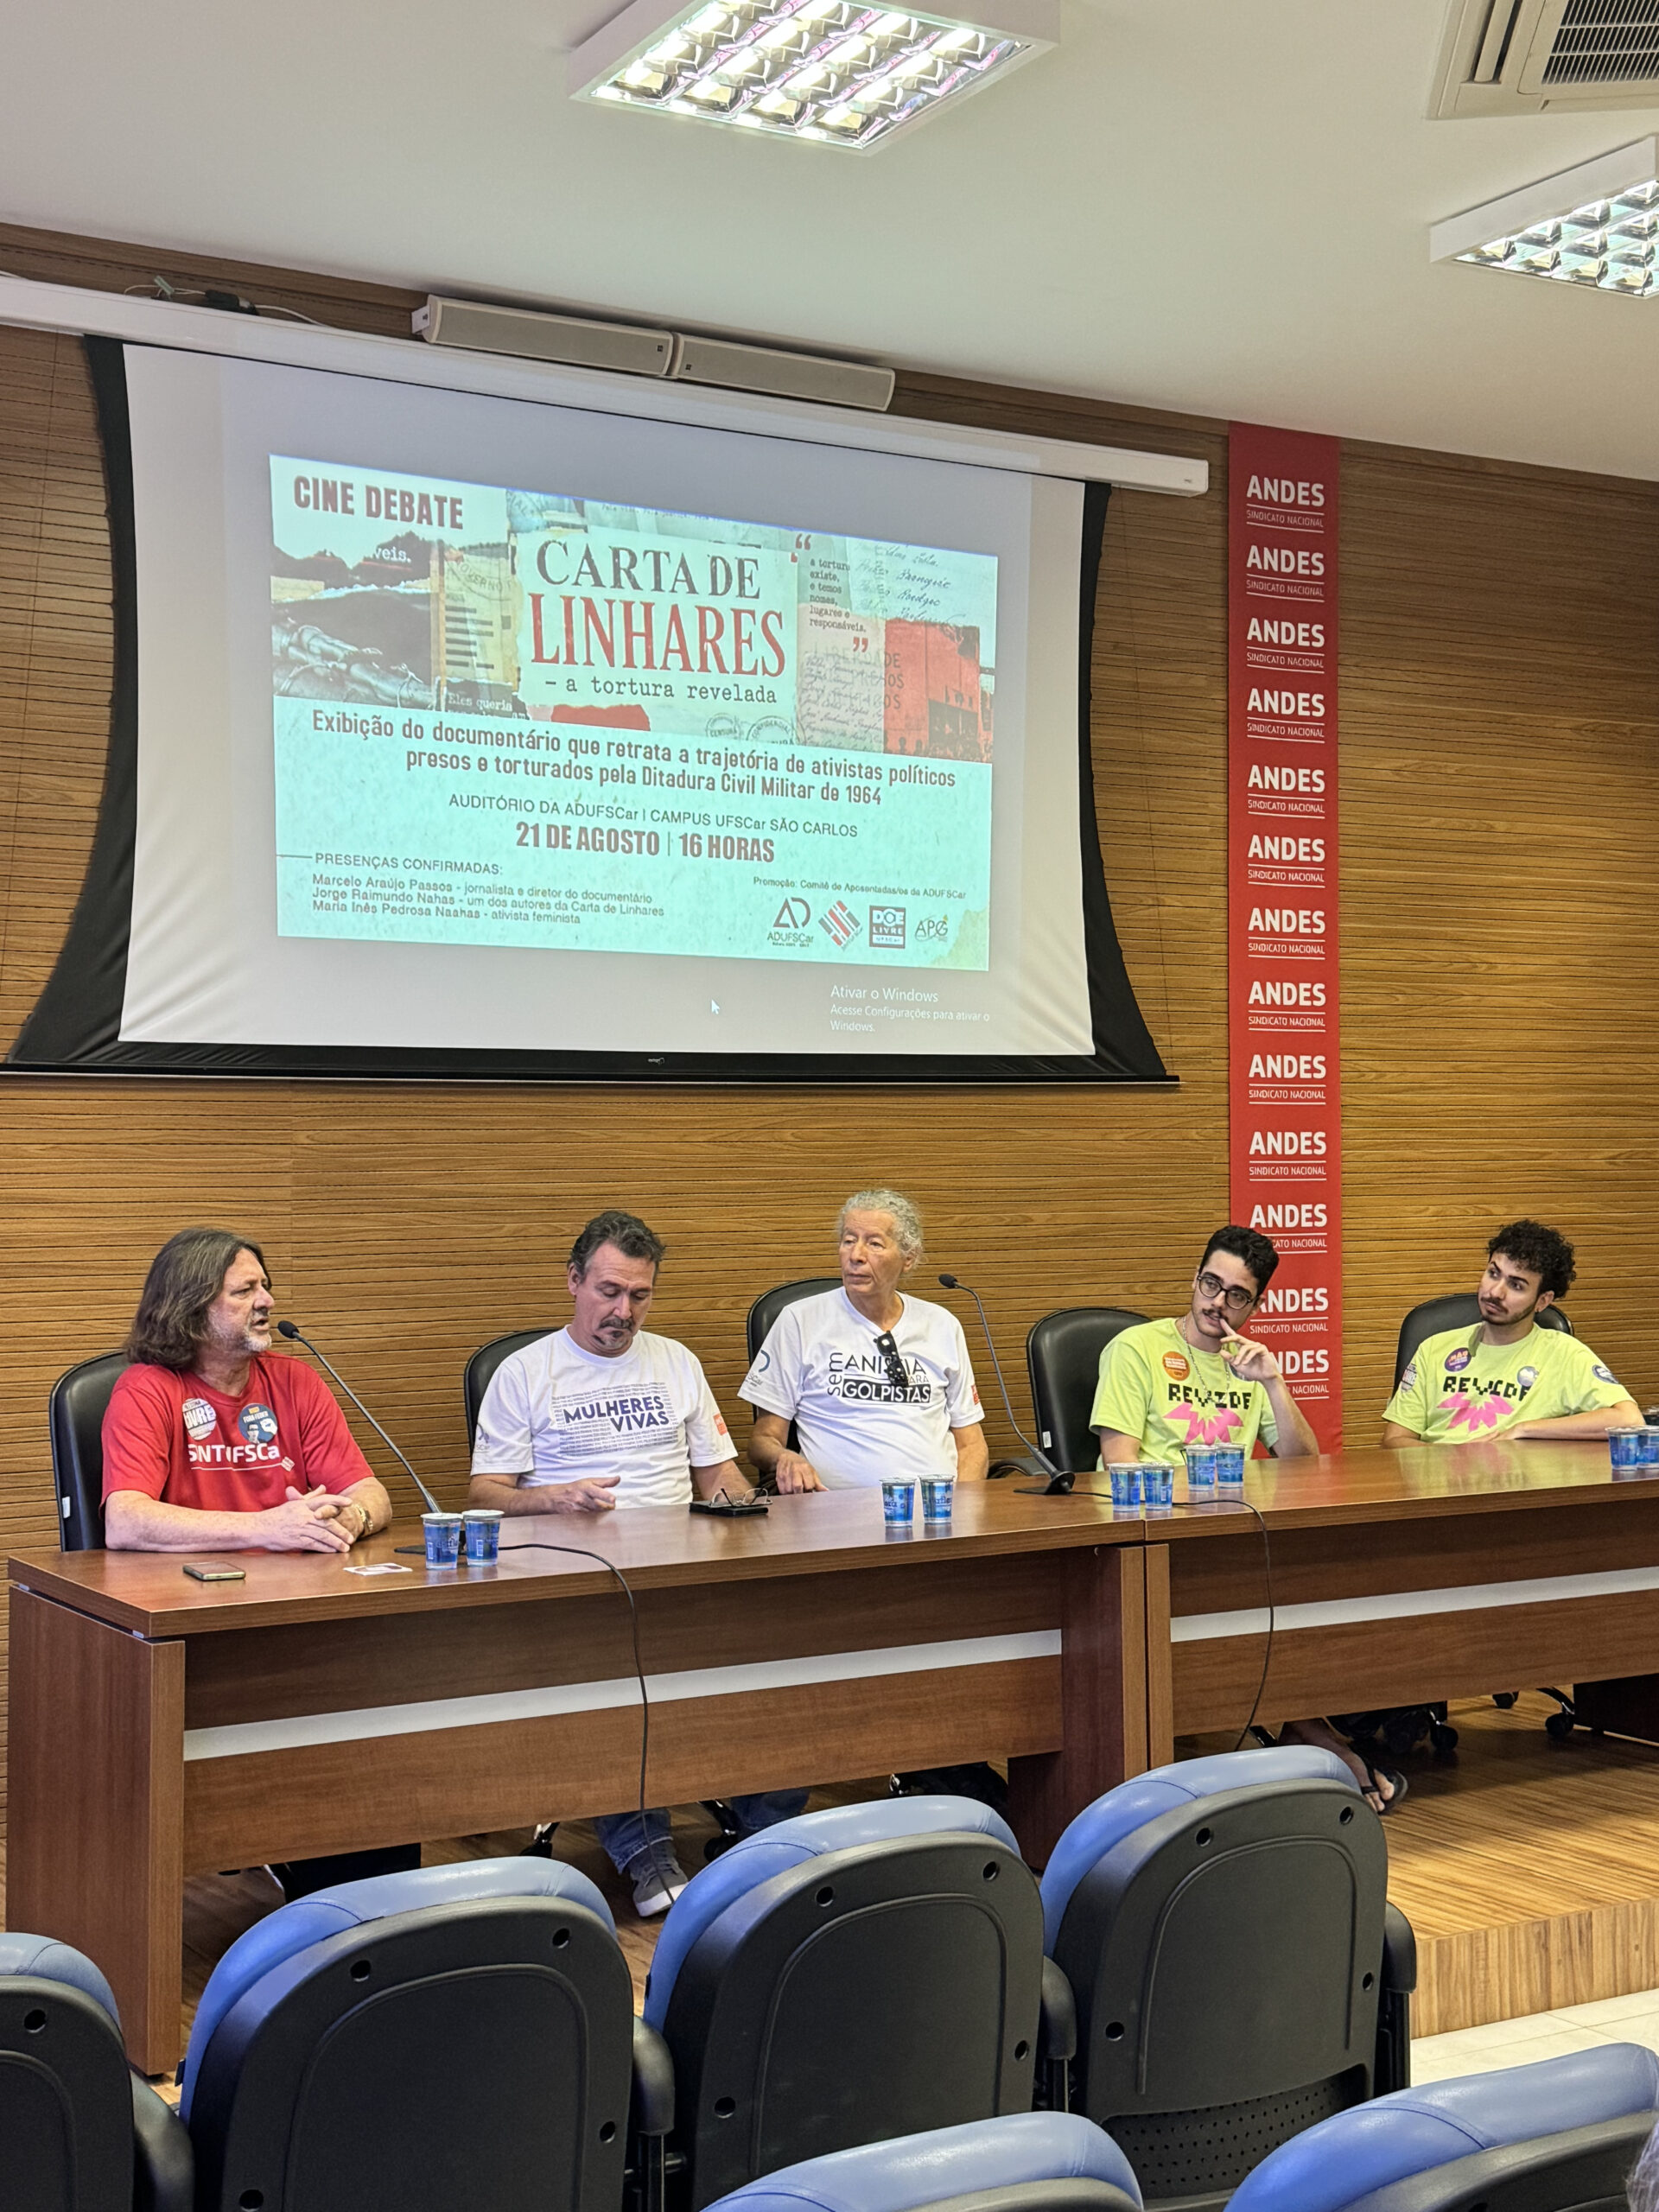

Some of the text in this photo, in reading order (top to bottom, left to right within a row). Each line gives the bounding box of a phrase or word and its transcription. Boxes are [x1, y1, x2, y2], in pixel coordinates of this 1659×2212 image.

[1246, 474, 1325, 507] ANDES
[294, 476, 464, 530] CINE DEBATE
[1246, 510, 1324, 528] SINDICATO NACIONAL
[537, 539, 761, 599] CARTA DE
[1246, 544, 1325, 576] ANDES
[1246, 580, 1324, 597] SINDICATO NACIONAL
[529, 593, 786, 677] LINHARES
[1247, 617, 1325, 648] ANDES
[1247, 652, 1324, 669] SINDICATO NACIONAL
[566, 676, 777, 703] a tortura revelada
[1247, 688, 1325, 717] ANDES
[1247, 723, 1325, 738] SINDICATO NACIONAL
[313, 709, 956, 787] Exibição do documentário que retrata a trajetória de ativistas políticos
[406, 750, 881, 805] presos e torturados pela Ditadura Civil Militar de 1964
[1248, 765, 1325, 793] ANDES
[449, 793, 858, 837] AUDITÓRIO DA ADUFSCar CAMPUS UFSCar SÃO CARLOS
[1248, 799, 1325, 813] SINDICATO NACIONAL
[516, 822, 774, 863] 21 DE AGOSTO 16 HORAS
[1248, 835, 1325, 862] ANDES
[315, 852, 503, 875] PRESENÇAS CONFIRMADAS:
[753, 876, 966, 899] Promoção: Comitê de Aposentadas/os da ADUFSCar
[1248, 870, 1325, 883] SINDICATO NACIONAL
[313, 874, 361, 887] Marcelo
[365, 877, 405, 891] Araújo
[410, 879, 452, 892] Passos
[464, 882, 514, 896] jornalista
[527, 887, 562, 898] diretor
[565, 888, 578, 899] do
[582, 889, 652, 904] documentário
[313, 887, 664, 917] Jorge Raimundo Nahas um dos autores da Carta de Linhares
[313, 900, 347, 912] Maria
[352, 902, 378, 913] Inês
[382, 903, 431, 916] Pedrosa
[491, 910, 529, 921] ativista
[532, 912, 581, 924] feminista
[873, 926, 903, 936] LIVRE
[1248, 907, 1325, 934] ANDES
[767, 932, 814, 944] ADUFSCar
[1248, 943, 1325, 955] SINDICATO NACIONAL
[830, 985, 938, 1003] Ativar o Windows
[1248, 981, 1325, 1007] ANDES
[830, 1004, 990, 1022] Acesse Configurações para ativar o
[1248, 1016, 1325, 1027] SINDICATO NACIONAL
[830, 1020, 876, 1033] Windows.
[1249, 1054, 1326, 1079] ANDES
[1249, 1090, 1326, 1099] SINDICATO NACIONAL
[1249, 1131, 1326, 1155] ANDES
[1249, 1165, 1326, 1176] SINDICATO NACIONAL
[1249, 1204, 1327, 1229] ANDES
[1292, 1237, 1327, 1248] NACIONAL
[1249, 1322, 1328, 1334] SINDICATO NACIONAL
[845, 1354, 926, 1376] ANIIA
[1269, 1349, 1329, 1375] NDES
[908, 1375, 930, 1384] ARA
[1293, 1384, 1329, 1394] NACIONAL
[843, 1382, 931, 1402] GOLPISTAS
[563, 1395, 664, 1424] MULHERES
[610, 1411, 670, 1432] VIVAS
